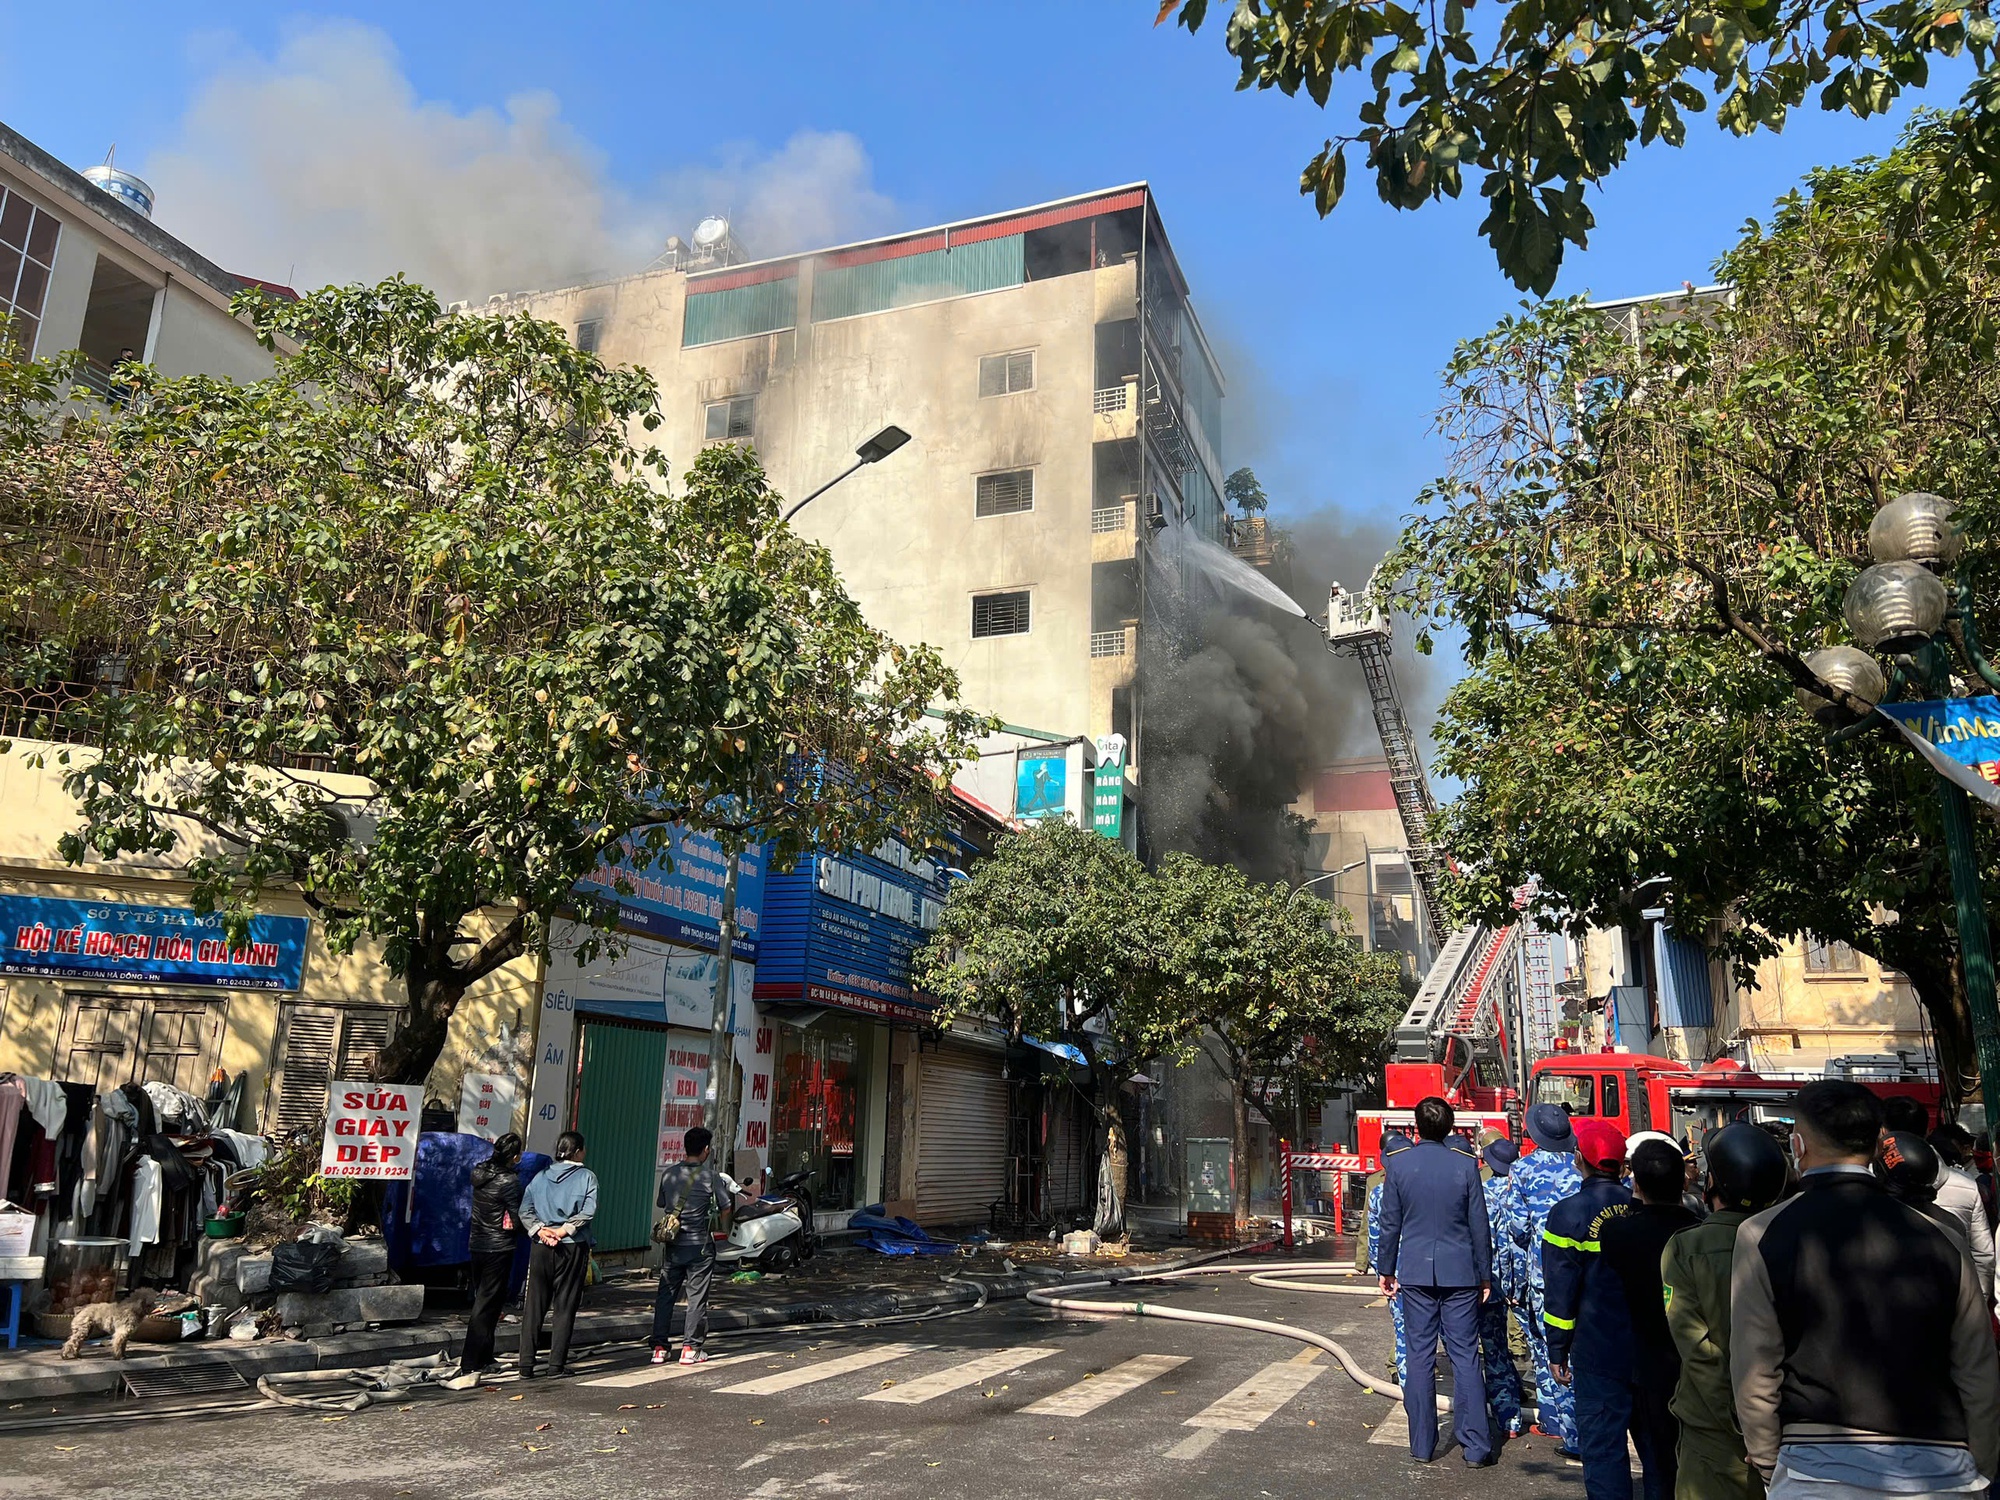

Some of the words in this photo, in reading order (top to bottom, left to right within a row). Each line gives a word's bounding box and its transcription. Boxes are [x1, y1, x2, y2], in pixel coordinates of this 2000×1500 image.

[1097, 739, 1118, 751] Vita
[1096, 775, 1121, 787] RĂNG
[1095, 794, 1117, 806] HÀM
[1095, 815, 1116, 826] MẶT
[851, 869, 881, 918] PHỤ
[880, 881, 913, 924] KHOA
[87, 906, 111, 919] SỞ
[116, 911, 129, 921] Y
[132, 909, 159, 924] TẾ
[162, 913, 188, 926] HÀ
[822, 909, 832, 919] SIÊU
[859, 921, 869, 931] KHOA
[828, 924, 843, 935] HOẠCH
[14, 922, 52, 956] HỘI
[53, 922, 87, 955] KẾ
[83, 930, 151, 962] HOẠCH
[153, 933, 193, 963] HÓA
[197, 939, 229, 964] GIA
[6, 965, 19, 974] ĐỊA
[39, 967, 49, 975] 90
[50, 967, 61, 975] LÊ
[62, 968, 76, 976] LỢI
[107, 971, 118, 979] HÀ
[605, 966, 625, 981] SIÊU
[640, 975, 650, 985] 4D
[545, 989, 574, 1012] SIÊU
[756, 1016, 773, 1055] SẢN
[544, 1042, 564, 1066] ÂM
[481, 1081, 494, 1093] sửa
[752, 1073, 769, 1107] PHỤ
[342, 1087, 408, 1111] SỬA
[539, 1103, 557, 1121] 4D
[334, 1115, 411, 1137] GIÀY
[745, 1121, 767, 1148] KHOA
[336, 1141, 401, 1163] DÉP
[324, 1166, 340, 1175] ĐT:
[342, 1166, 361, 1175] 032
[363, 1167, 381, 1175] 891
[385, 1167, 409, 1176] 9234
[1587, 1215, 1604, 1239] CẢNH
[1600, 1206, 1614, 1219] SÁT
